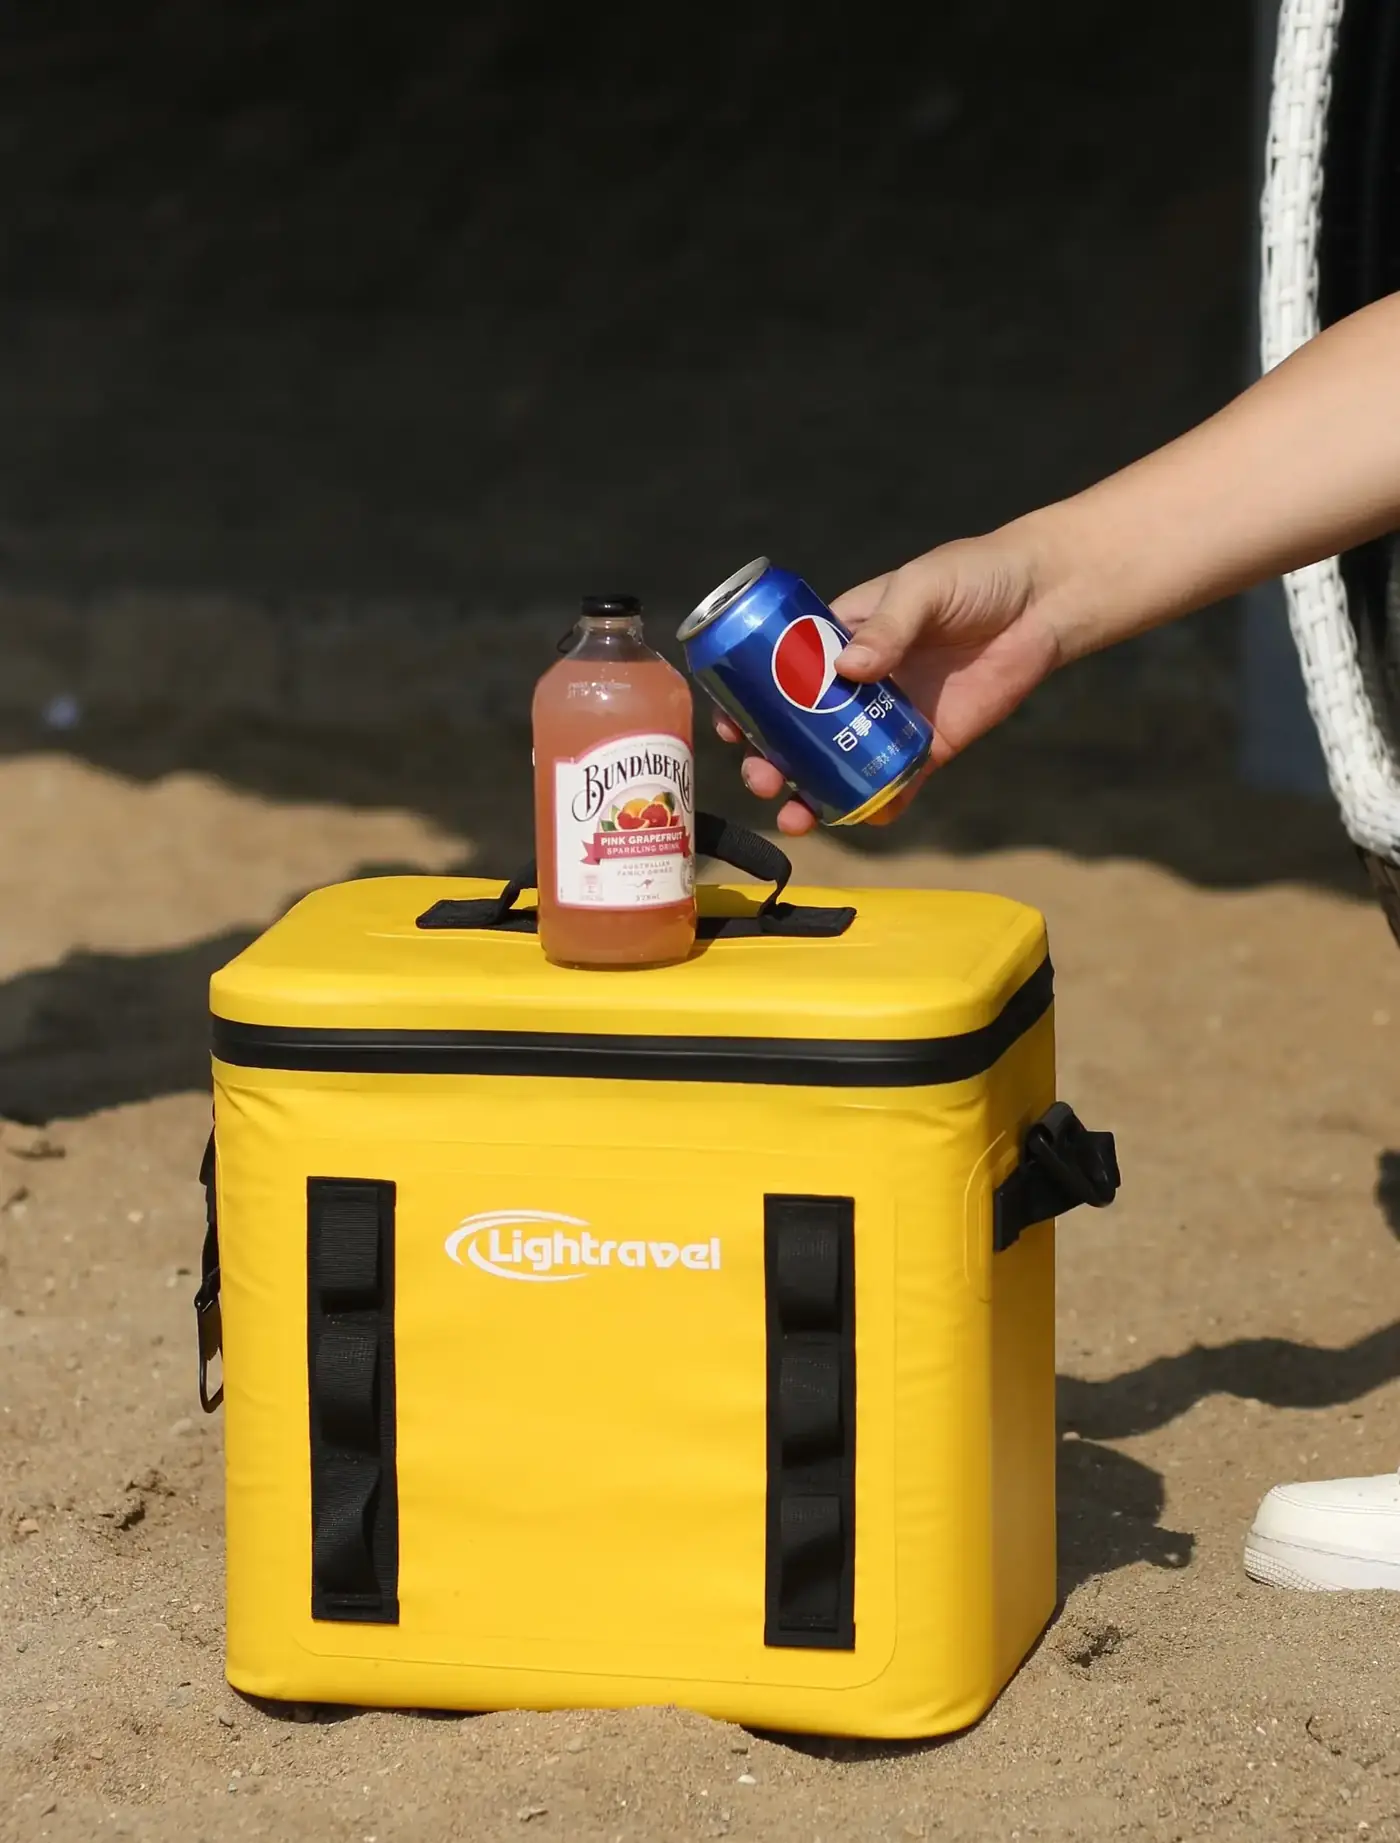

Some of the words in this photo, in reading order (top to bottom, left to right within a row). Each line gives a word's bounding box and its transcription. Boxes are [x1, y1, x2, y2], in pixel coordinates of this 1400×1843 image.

[832, 689, 895, 752] 百事可乐
[571, 748, 693, 822] BUNDABERG
[600, 836, 626, 846] PINK
[628, 832, 683, 845] GRAPEFRUIT
[606, 845, 657, 856] SPARKLING
[658, 842, 680, 852] DRINK
[488, 1228, 721, 1272] Lightravel
